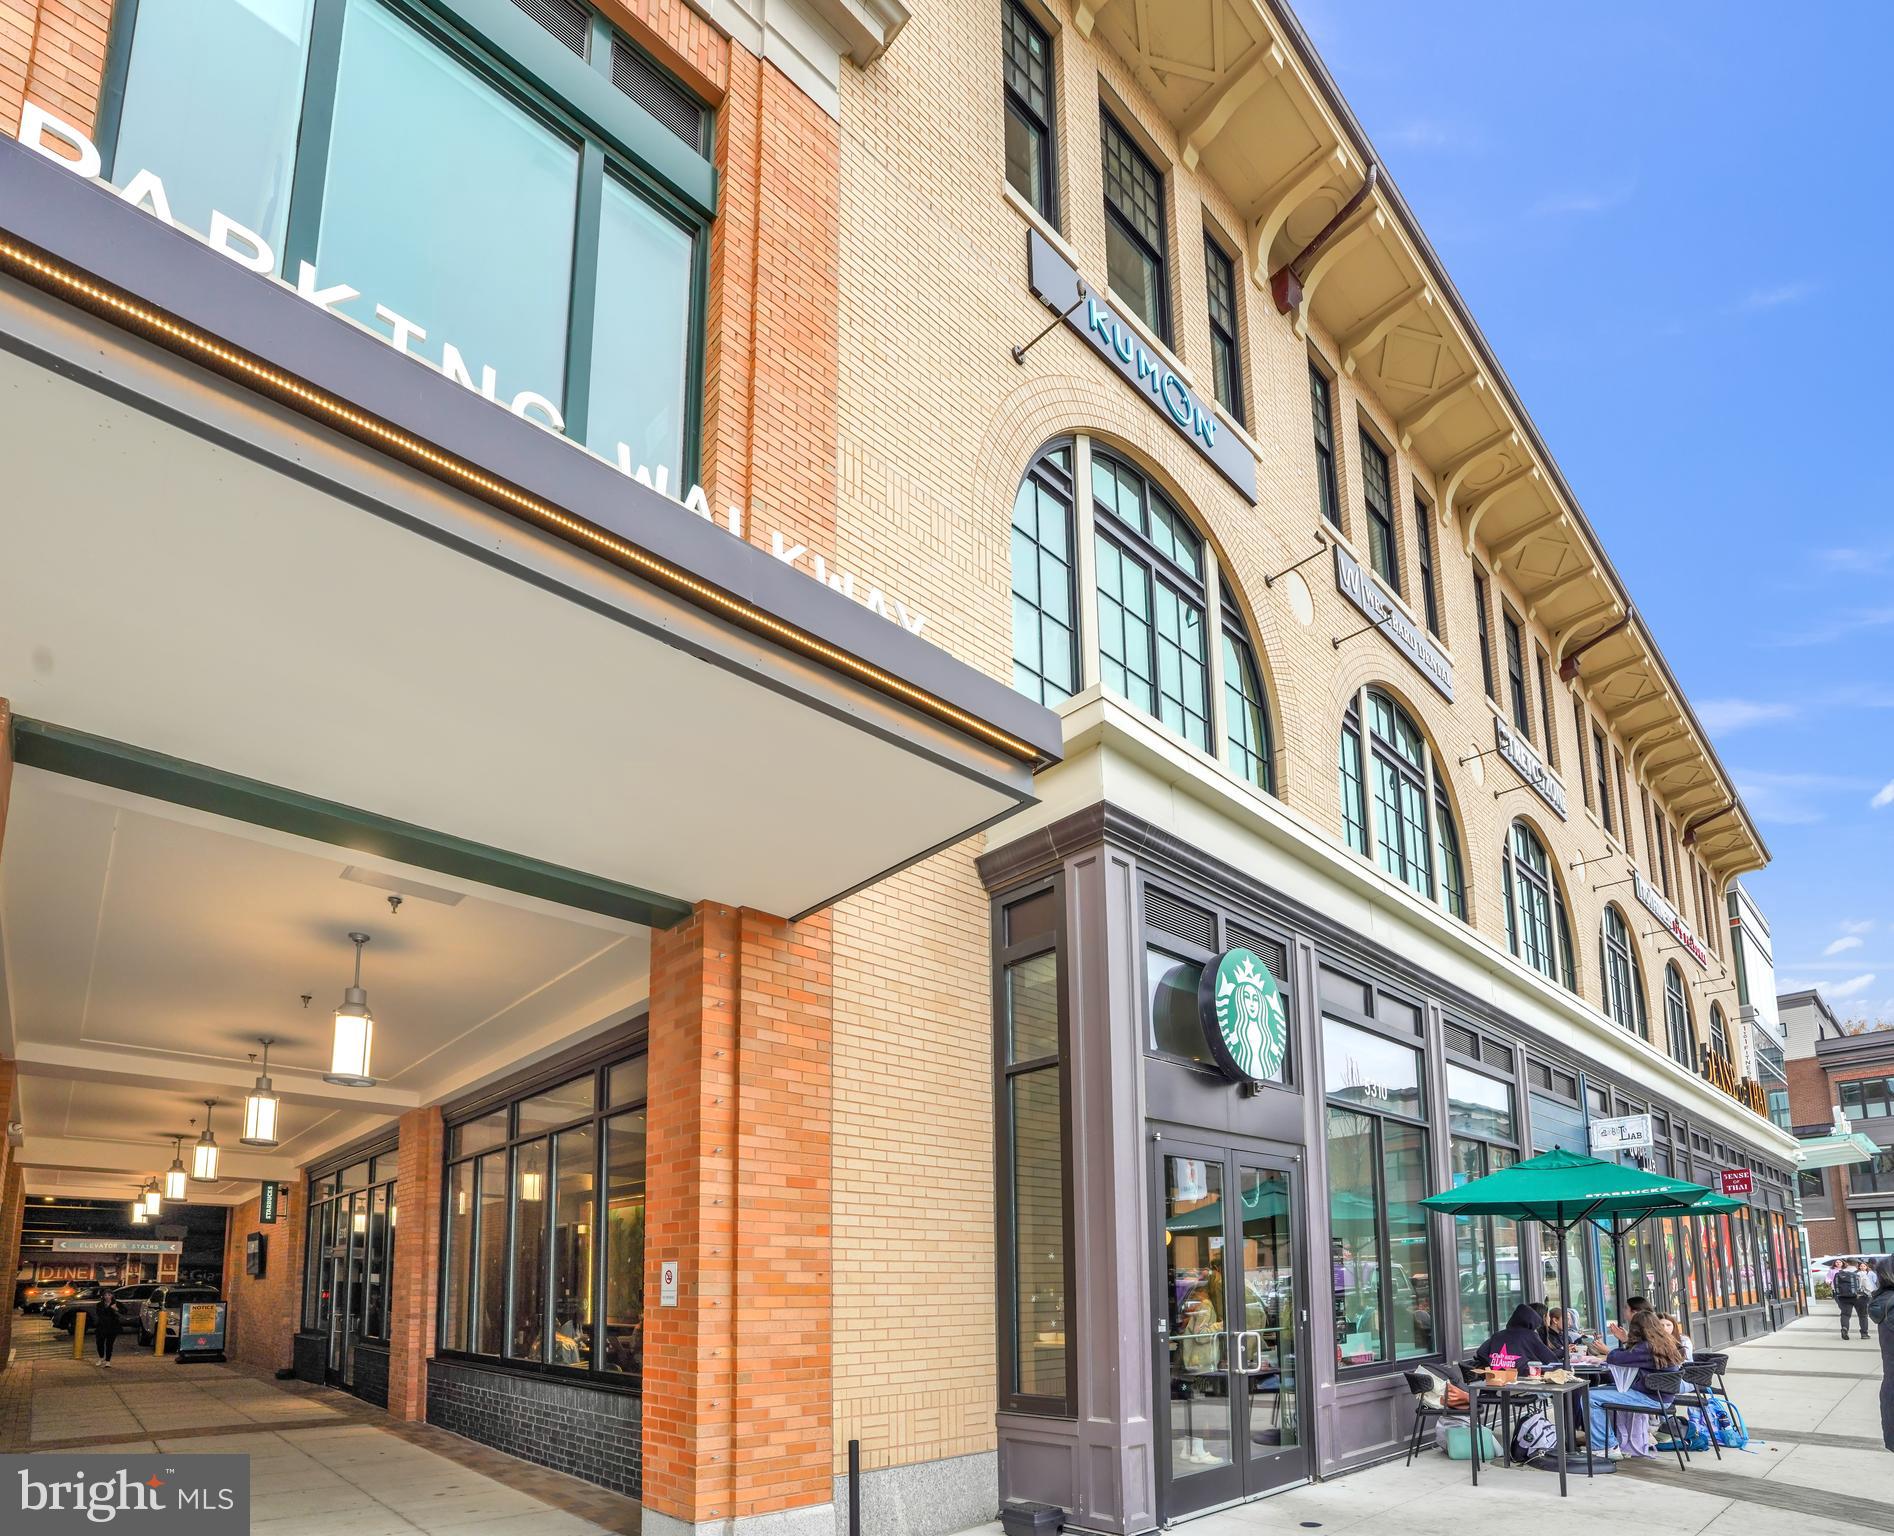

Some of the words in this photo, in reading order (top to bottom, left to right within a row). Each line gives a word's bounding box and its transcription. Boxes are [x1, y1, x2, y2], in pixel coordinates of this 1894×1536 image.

[1089, 298, 1217, 448] KUMON
[1417, 642, 1453, 690] DENTAL
[1364, 1080, 1388, 1101] 5310
[1723, 1172, 1750, 1180] SENSE
[265, 1185, 274, 1220] STARBUCKS
[1585, 1187, 1668, 1198] STARBUCKS
[41, 1266, 88, 1279] DINE
